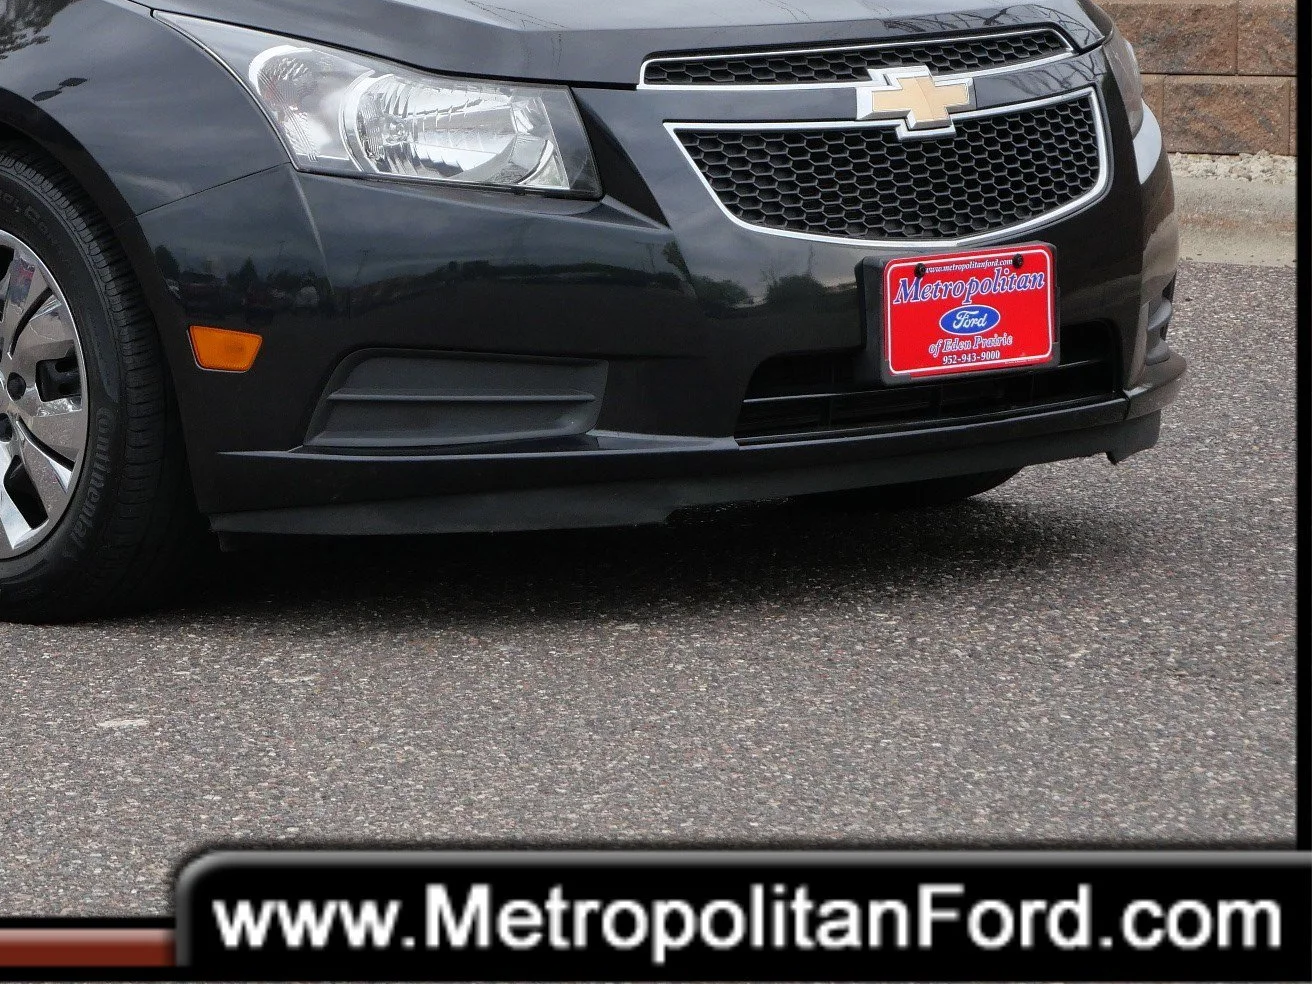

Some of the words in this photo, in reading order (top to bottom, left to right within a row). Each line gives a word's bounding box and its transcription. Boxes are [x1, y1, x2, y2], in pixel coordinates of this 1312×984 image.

[893, 267, 1045, 305] Metropolitan
[952, 310, 988, 330] Ford
[929, 339, 943, 358] of
[942, 338, 971, 352] Eden
[973, 333, 1013, 349] Prairie
[943, 350, 1000, 364] 952-943-9000
